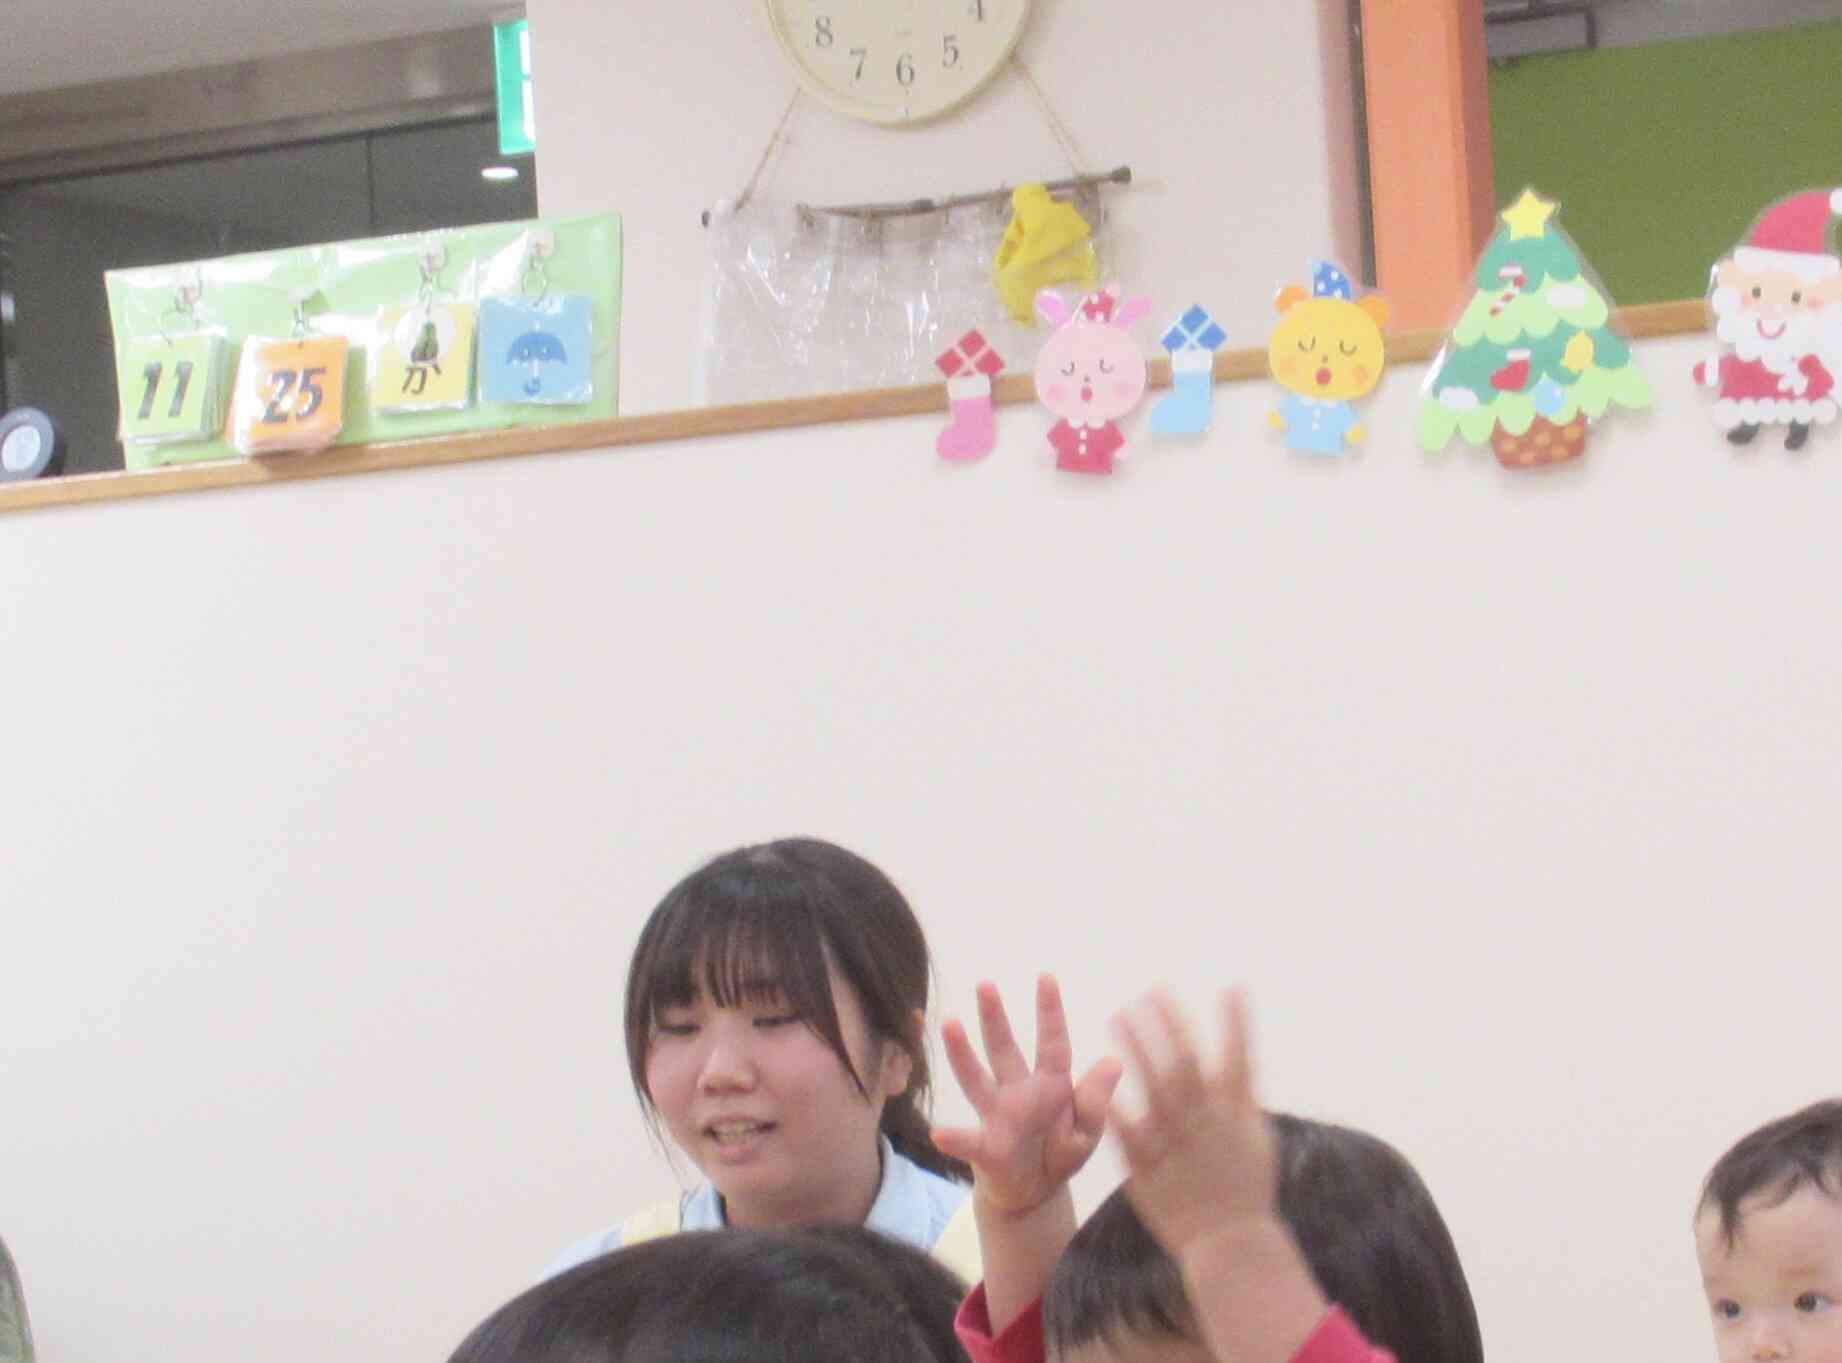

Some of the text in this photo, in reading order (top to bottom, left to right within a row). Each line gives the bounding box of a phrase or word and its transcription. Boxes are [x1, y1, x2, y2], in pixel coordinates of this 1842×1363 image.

[815, 15, 834, 48] 8
[849, 47, 868, 80] 7
[942, 34, 960, 69] 5
[895, 52, 915, 87] 6
[137, 359, 194, 419] 11
[262, 366, 328, 423] 25
